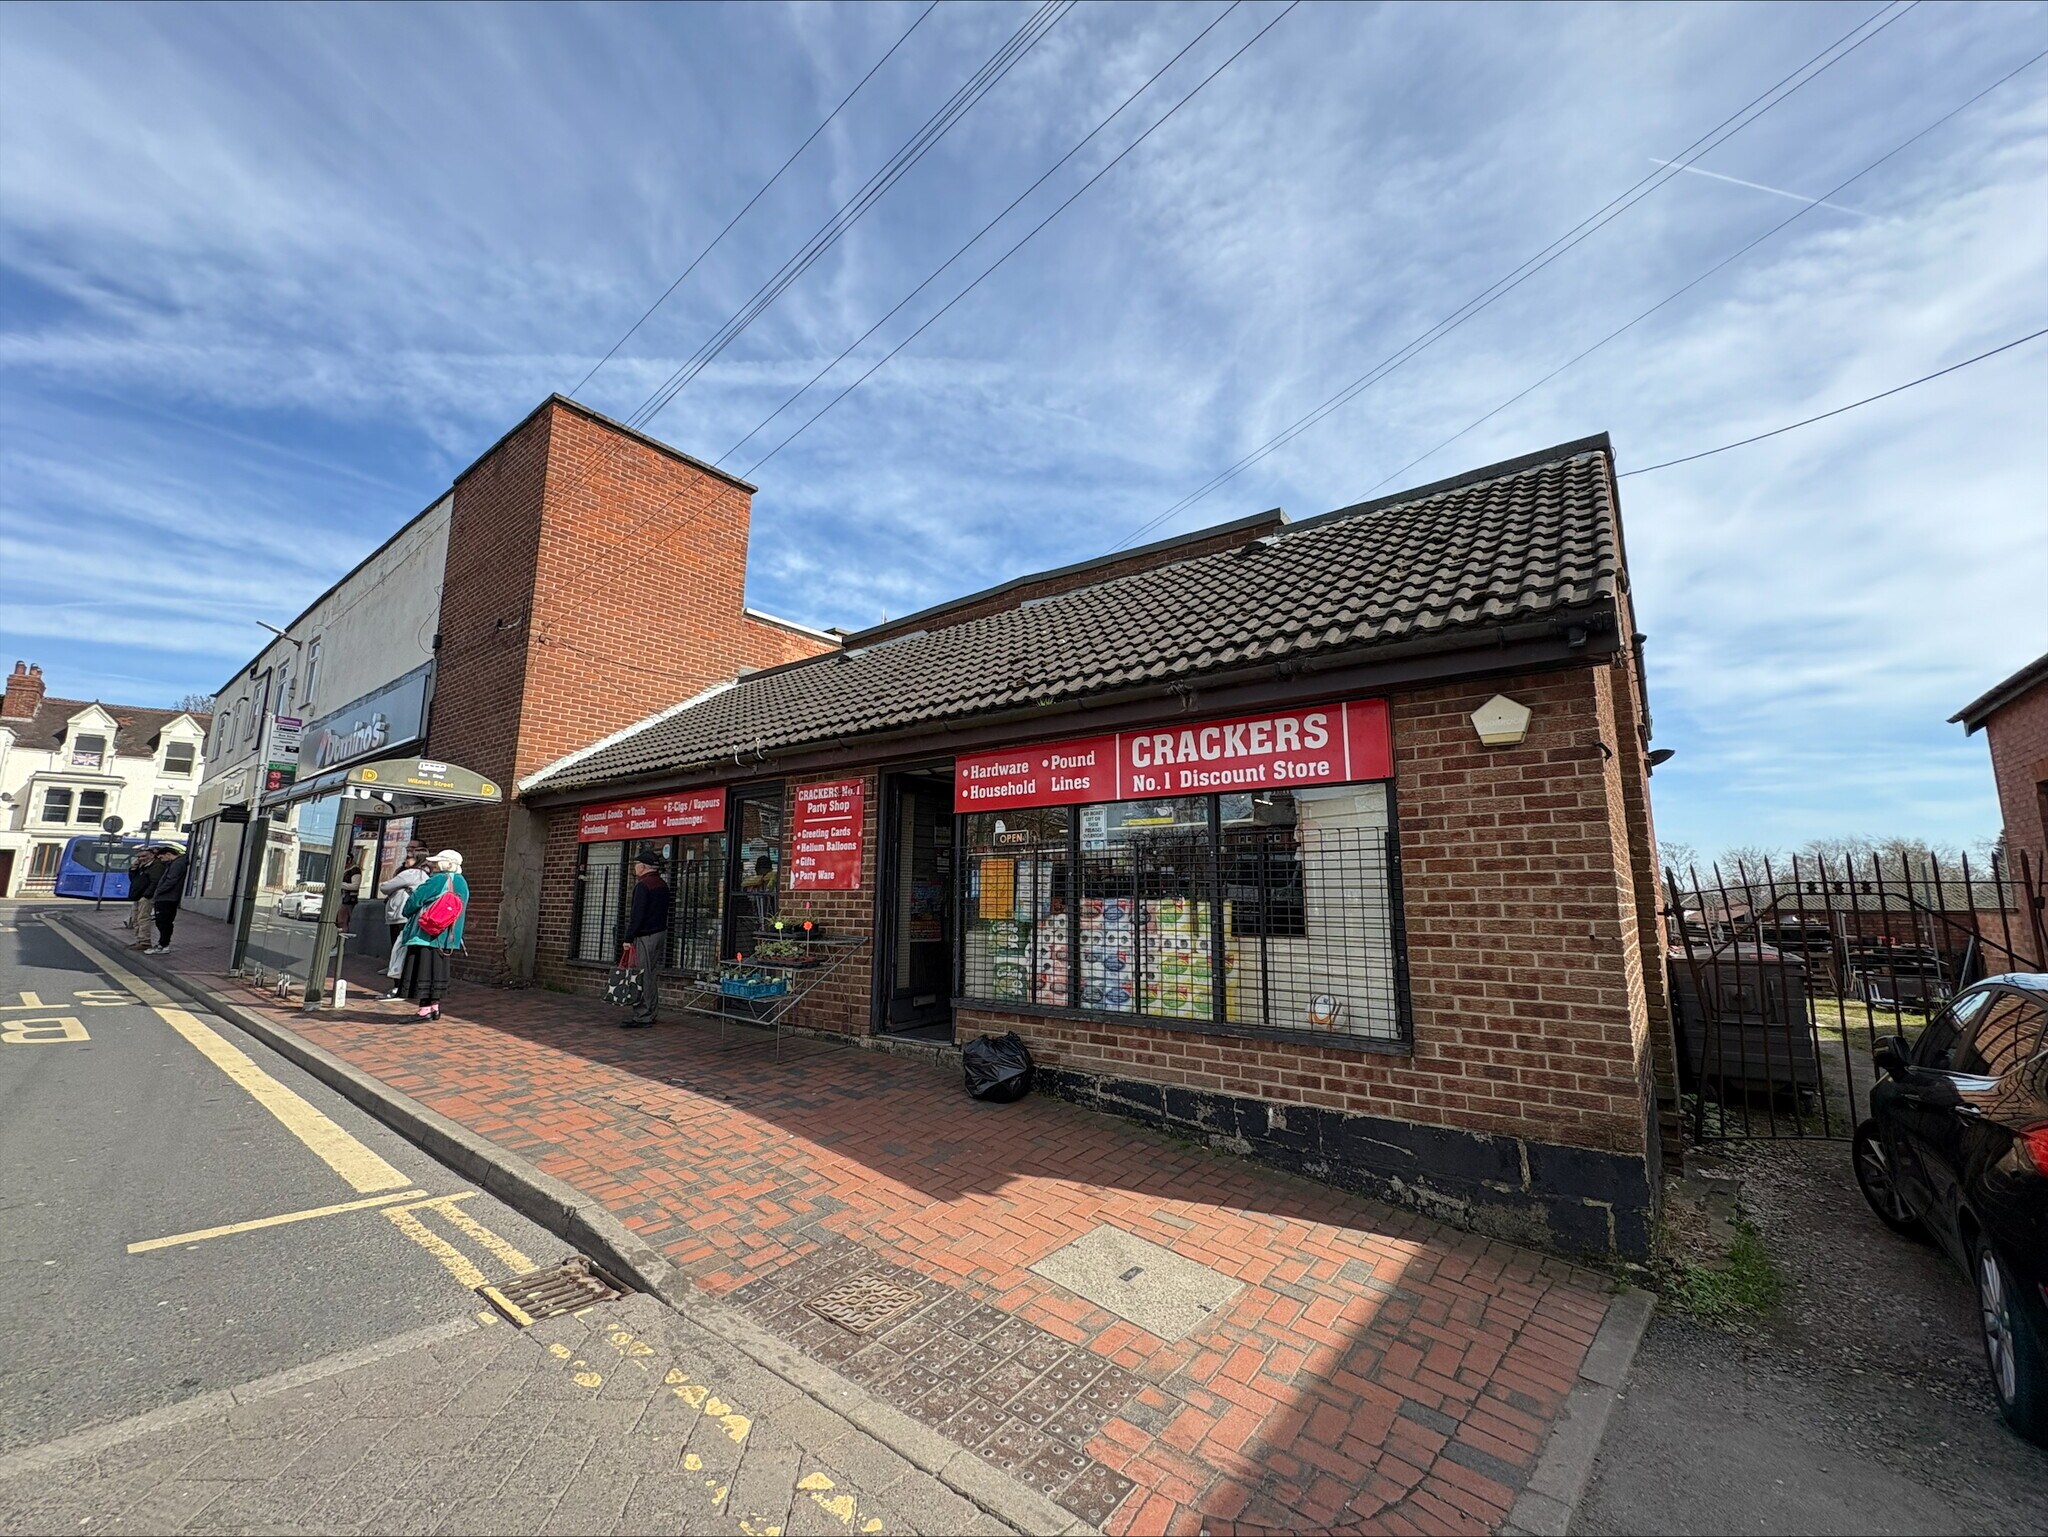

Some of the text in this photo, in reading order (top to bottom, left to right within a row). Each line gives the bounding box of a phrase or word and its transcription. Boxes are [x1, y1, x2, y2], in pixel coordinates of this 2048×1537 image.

[324, 713, 386, 766] Domino's
[1131, 713, 1329, 768] CRACKERS
[970, 750, 1095, 779] Hardware Pound
[1179, 763, 1266, 789] Discount
[1273, 759, 1330, 780] Store
[407, 777, 454, 789] Wilmot Street
[970, 774, 1090, 800] Household Lines
[798, 786, 839, 801] CRACKERS
[630, 806, 646, 817] Tools
[667, 801, 688, 813] E-Cigs
[693, 798, 720, 811] Vapours
[807, 800, 850, 815] Party Shop
[585, 809, 623, 822] Seasonal Goods
[584, 824, 608, 835] Gardening
[630, 818, 657, 830] Electrical
[801, 826, 851, 840] Greeting Cards
[1000, 833, 1023, 844] OPEN
[800, 841, 857, 853] Helium Balloons
[800, 856, 816, 867] Gifts
[799, 870, 835, 882] Party Ware
